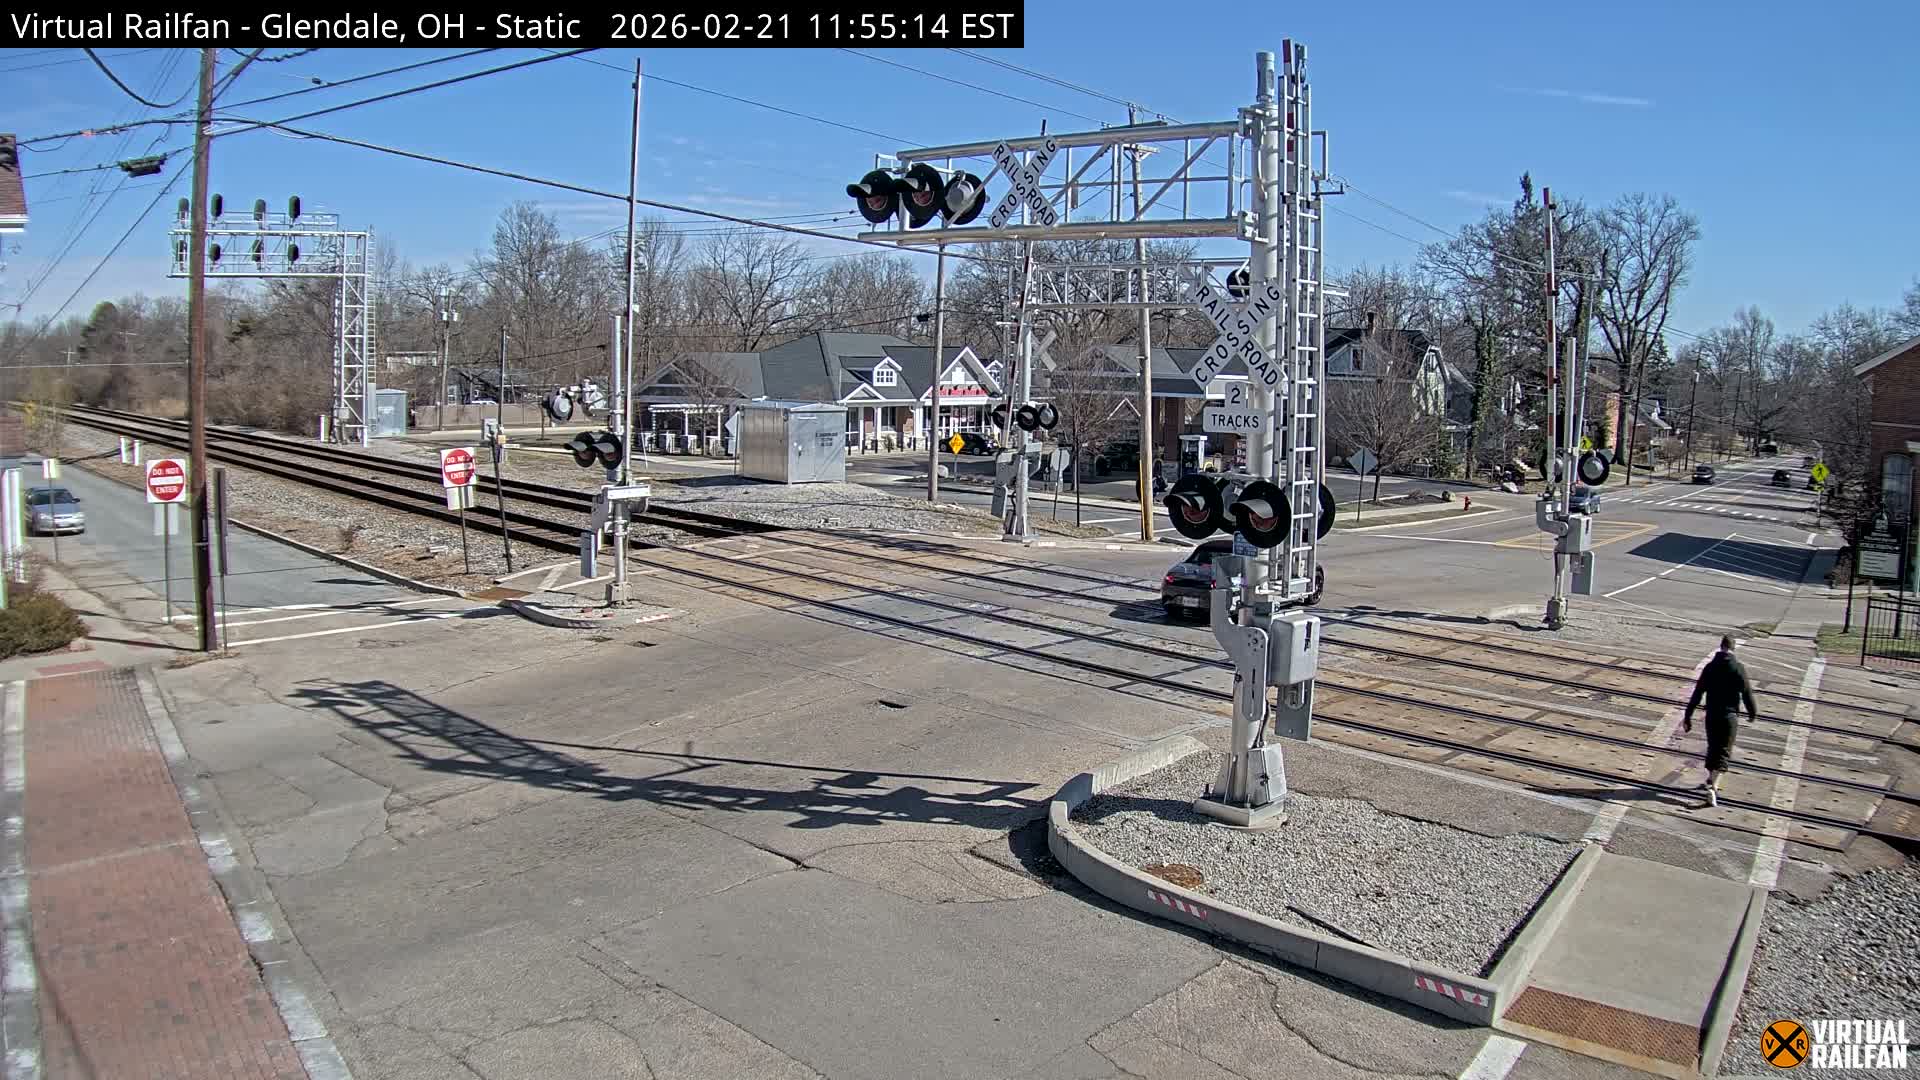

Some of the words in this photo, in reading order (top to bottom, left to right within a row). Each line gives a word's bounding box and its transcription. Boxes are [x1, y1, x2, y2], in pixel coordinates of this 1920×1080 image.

[991, 139, 1056, 228] CROSSING
[1195, 285, 1280, 383] CROSSING
[1211, 414, 1259, 428] TRACKS
[1231, 387, 1241, 404] 2
